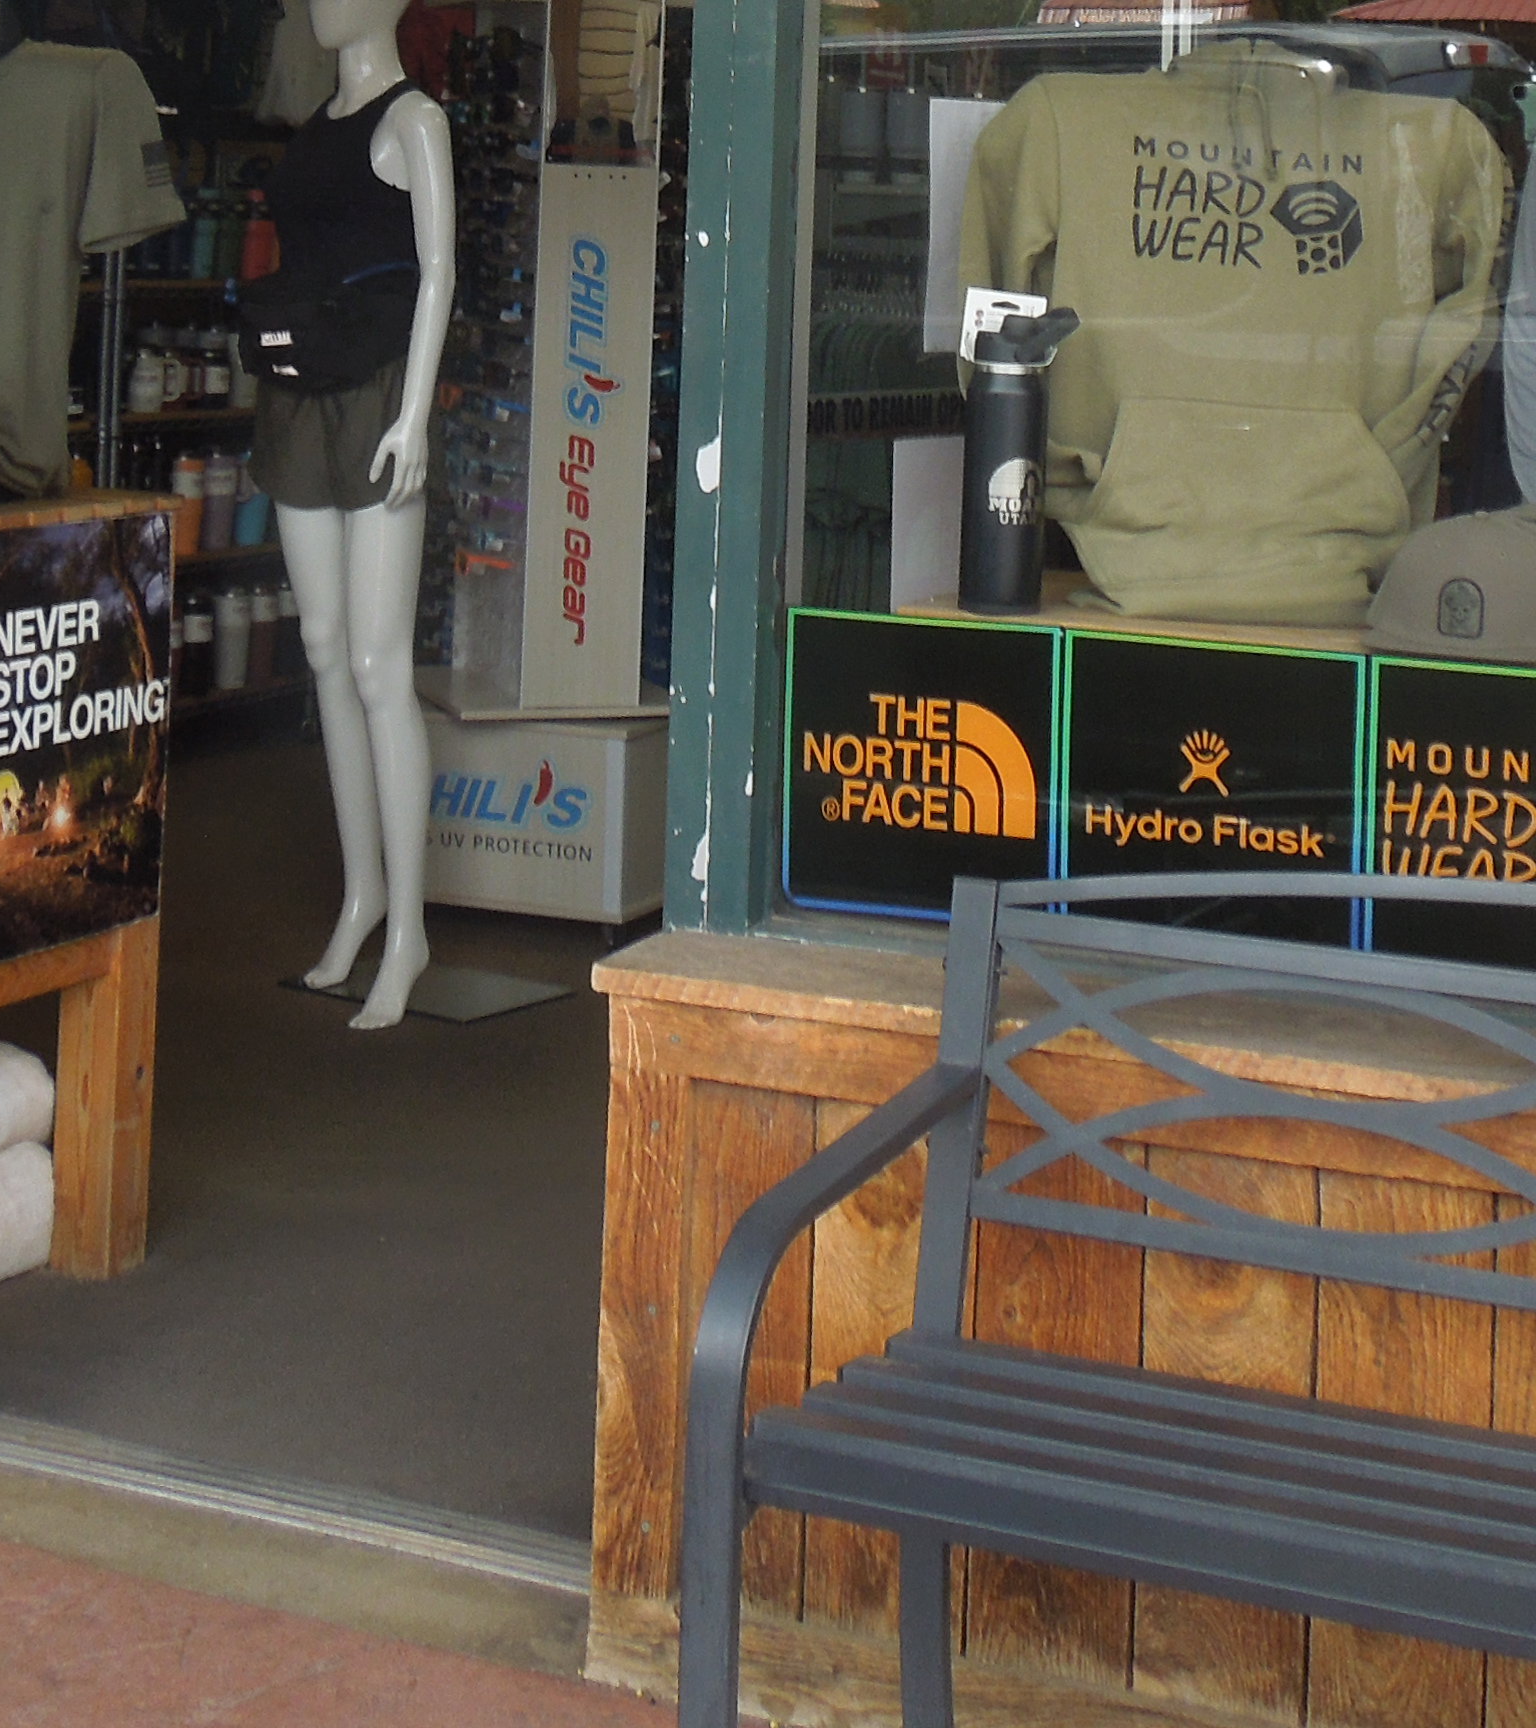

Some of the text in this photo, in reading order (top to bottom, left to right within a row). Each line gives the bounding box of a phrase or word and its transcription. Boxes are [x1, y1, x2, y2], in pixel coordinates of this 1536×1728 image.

[1133, 135, 1362, 174] MOUNTAIN
[1132, 165, 1266, 218] HARD
[1132, 213, 1263, 269] WEAR
[560, 238, 616, 647] CHILI'S Eye Gear
[870, 693, 951, 741] THE
[802, 730, 951, 788] NORTH
[430, 759, 588, 829] HILI'S
[840, 777, 950, 834] FACE
[440, 832, 593, 863] UV PROTECTION
[1084, 802, 1327, 859] Hydro Flask
